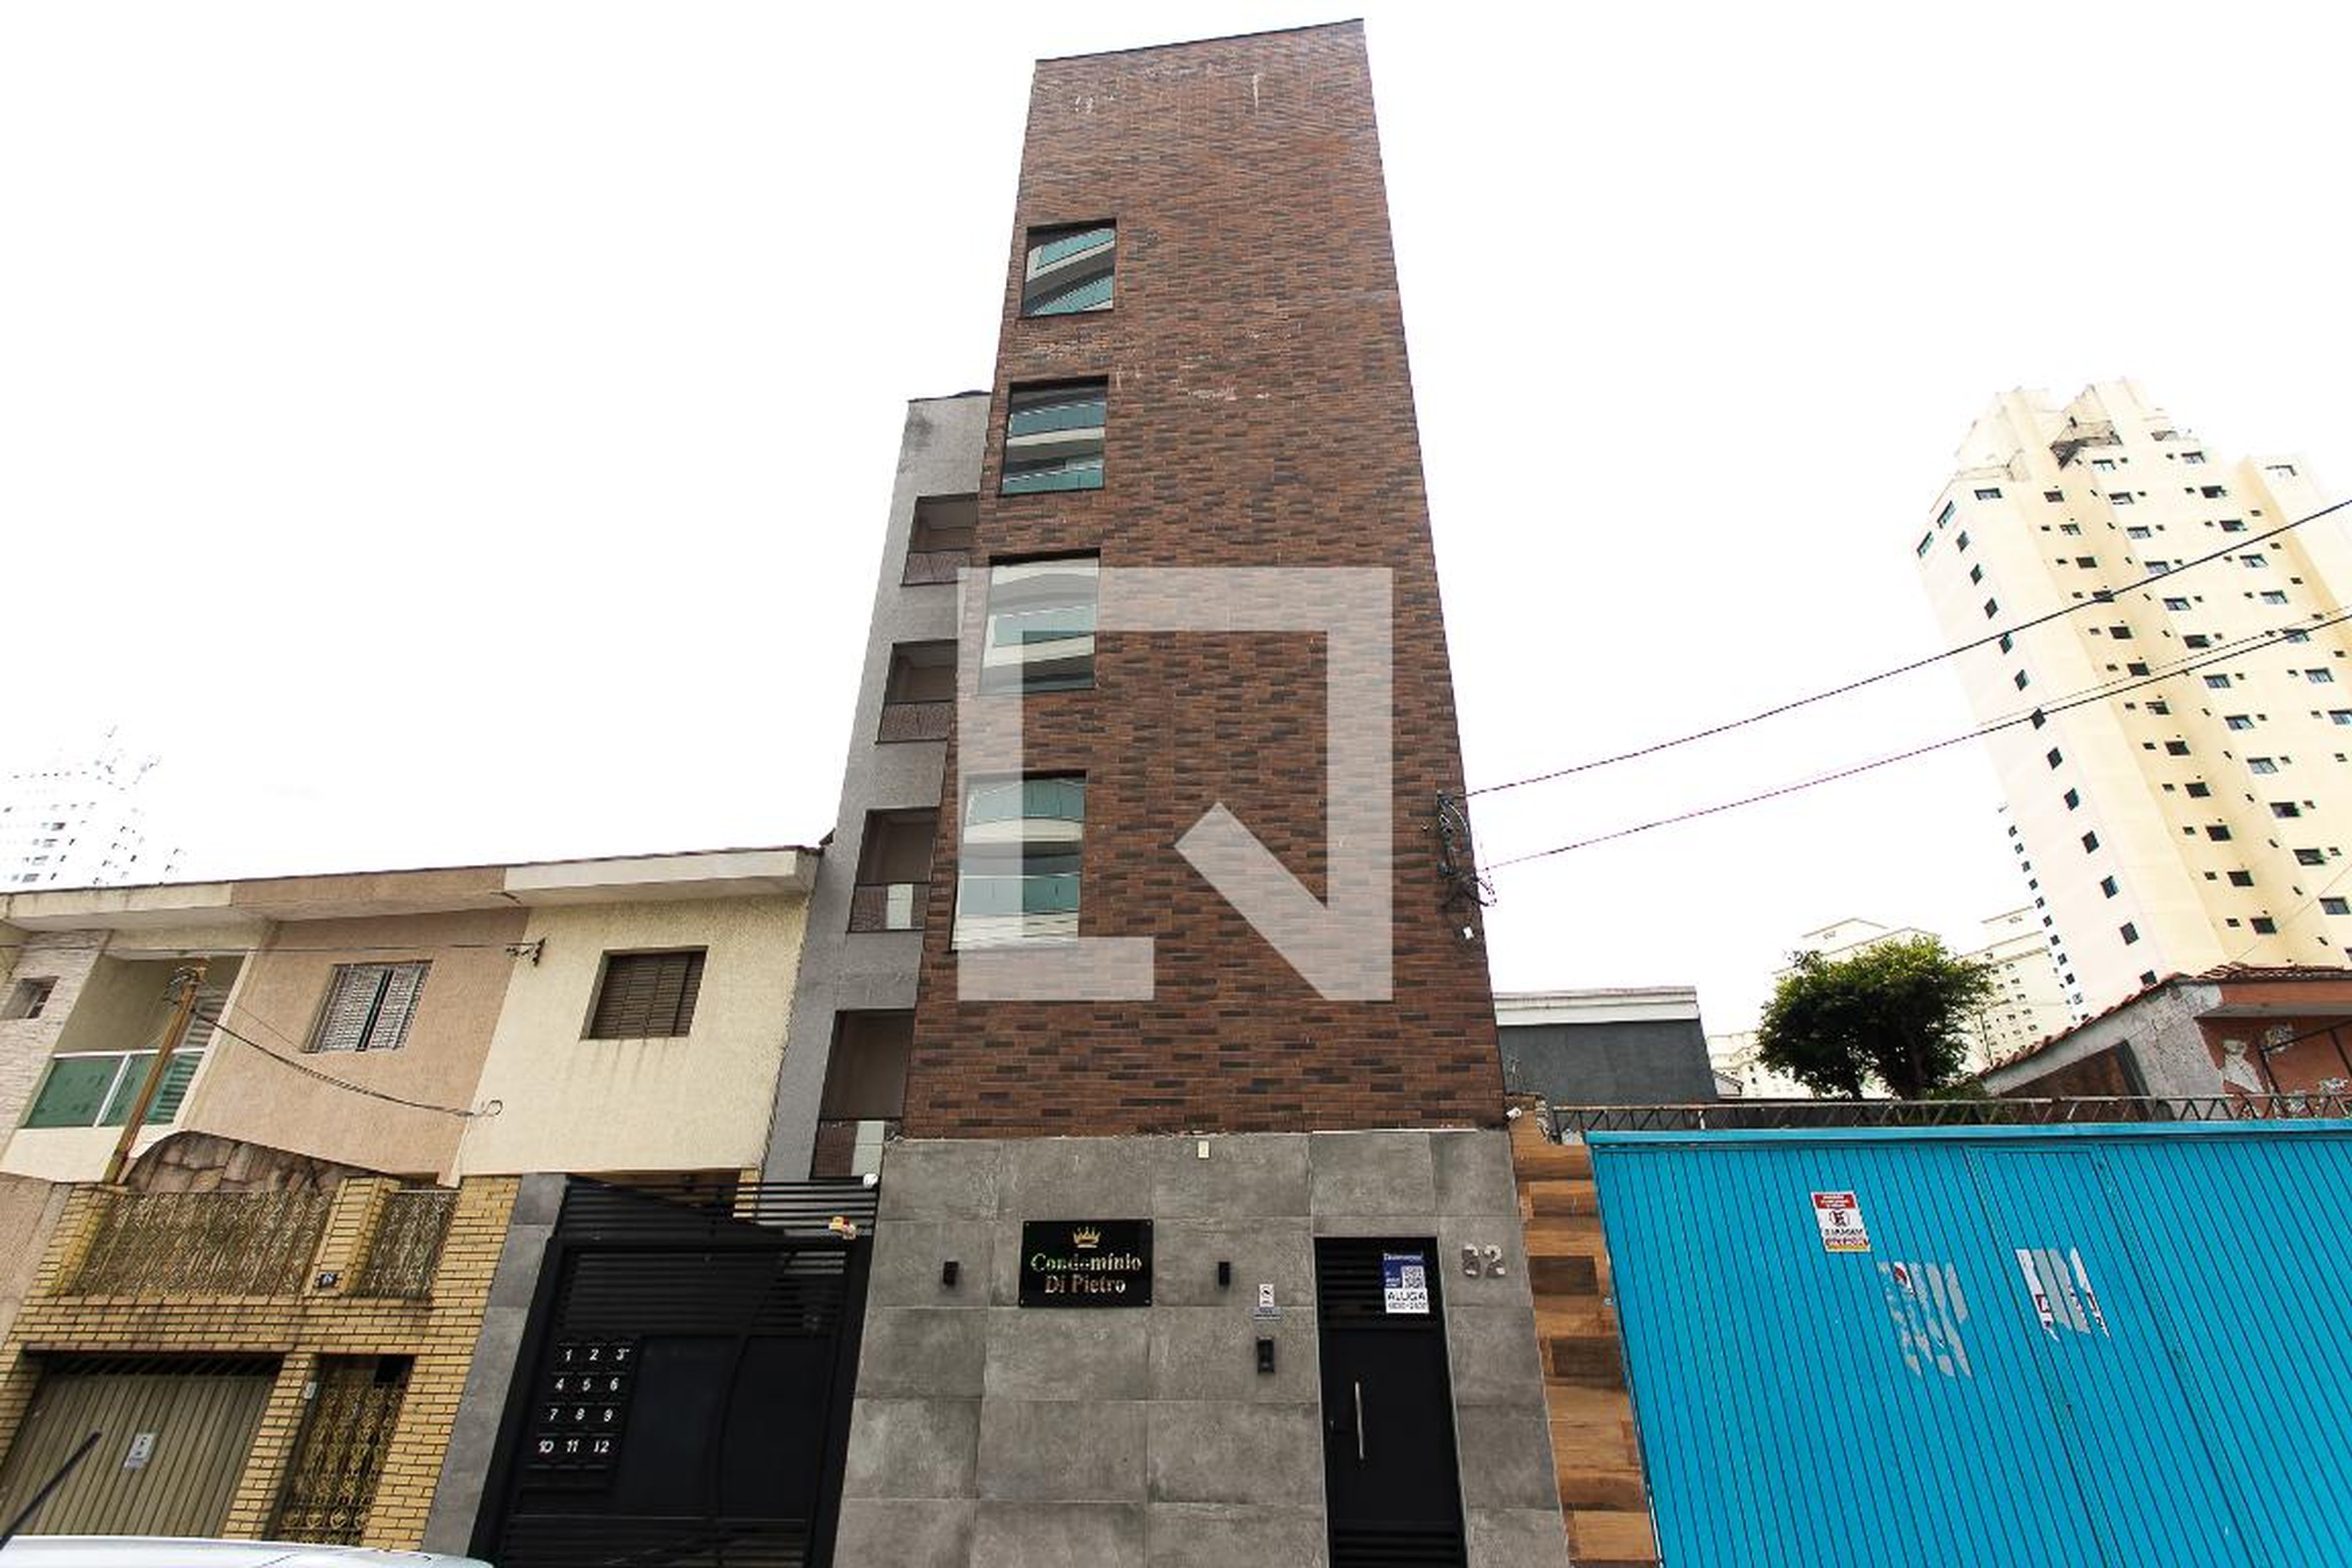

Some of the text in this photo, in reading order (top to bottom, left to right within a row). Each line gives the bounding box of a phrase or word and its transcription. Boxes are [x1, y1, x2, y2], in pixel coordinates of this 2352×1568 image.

[1045, 1275, 1126, 1294] Di Pietro
[1388, 1291, 1426, 1301] ALUGA
[565, 1349, 573, 1362] 1
[589, 1348, 599, 1360] 2
[555, 1378, 619, 1391] 4 5 6
[549, 1408, 612, 1422] 7 8 9
[538, 1439, 609, 1453] 10 11 12
